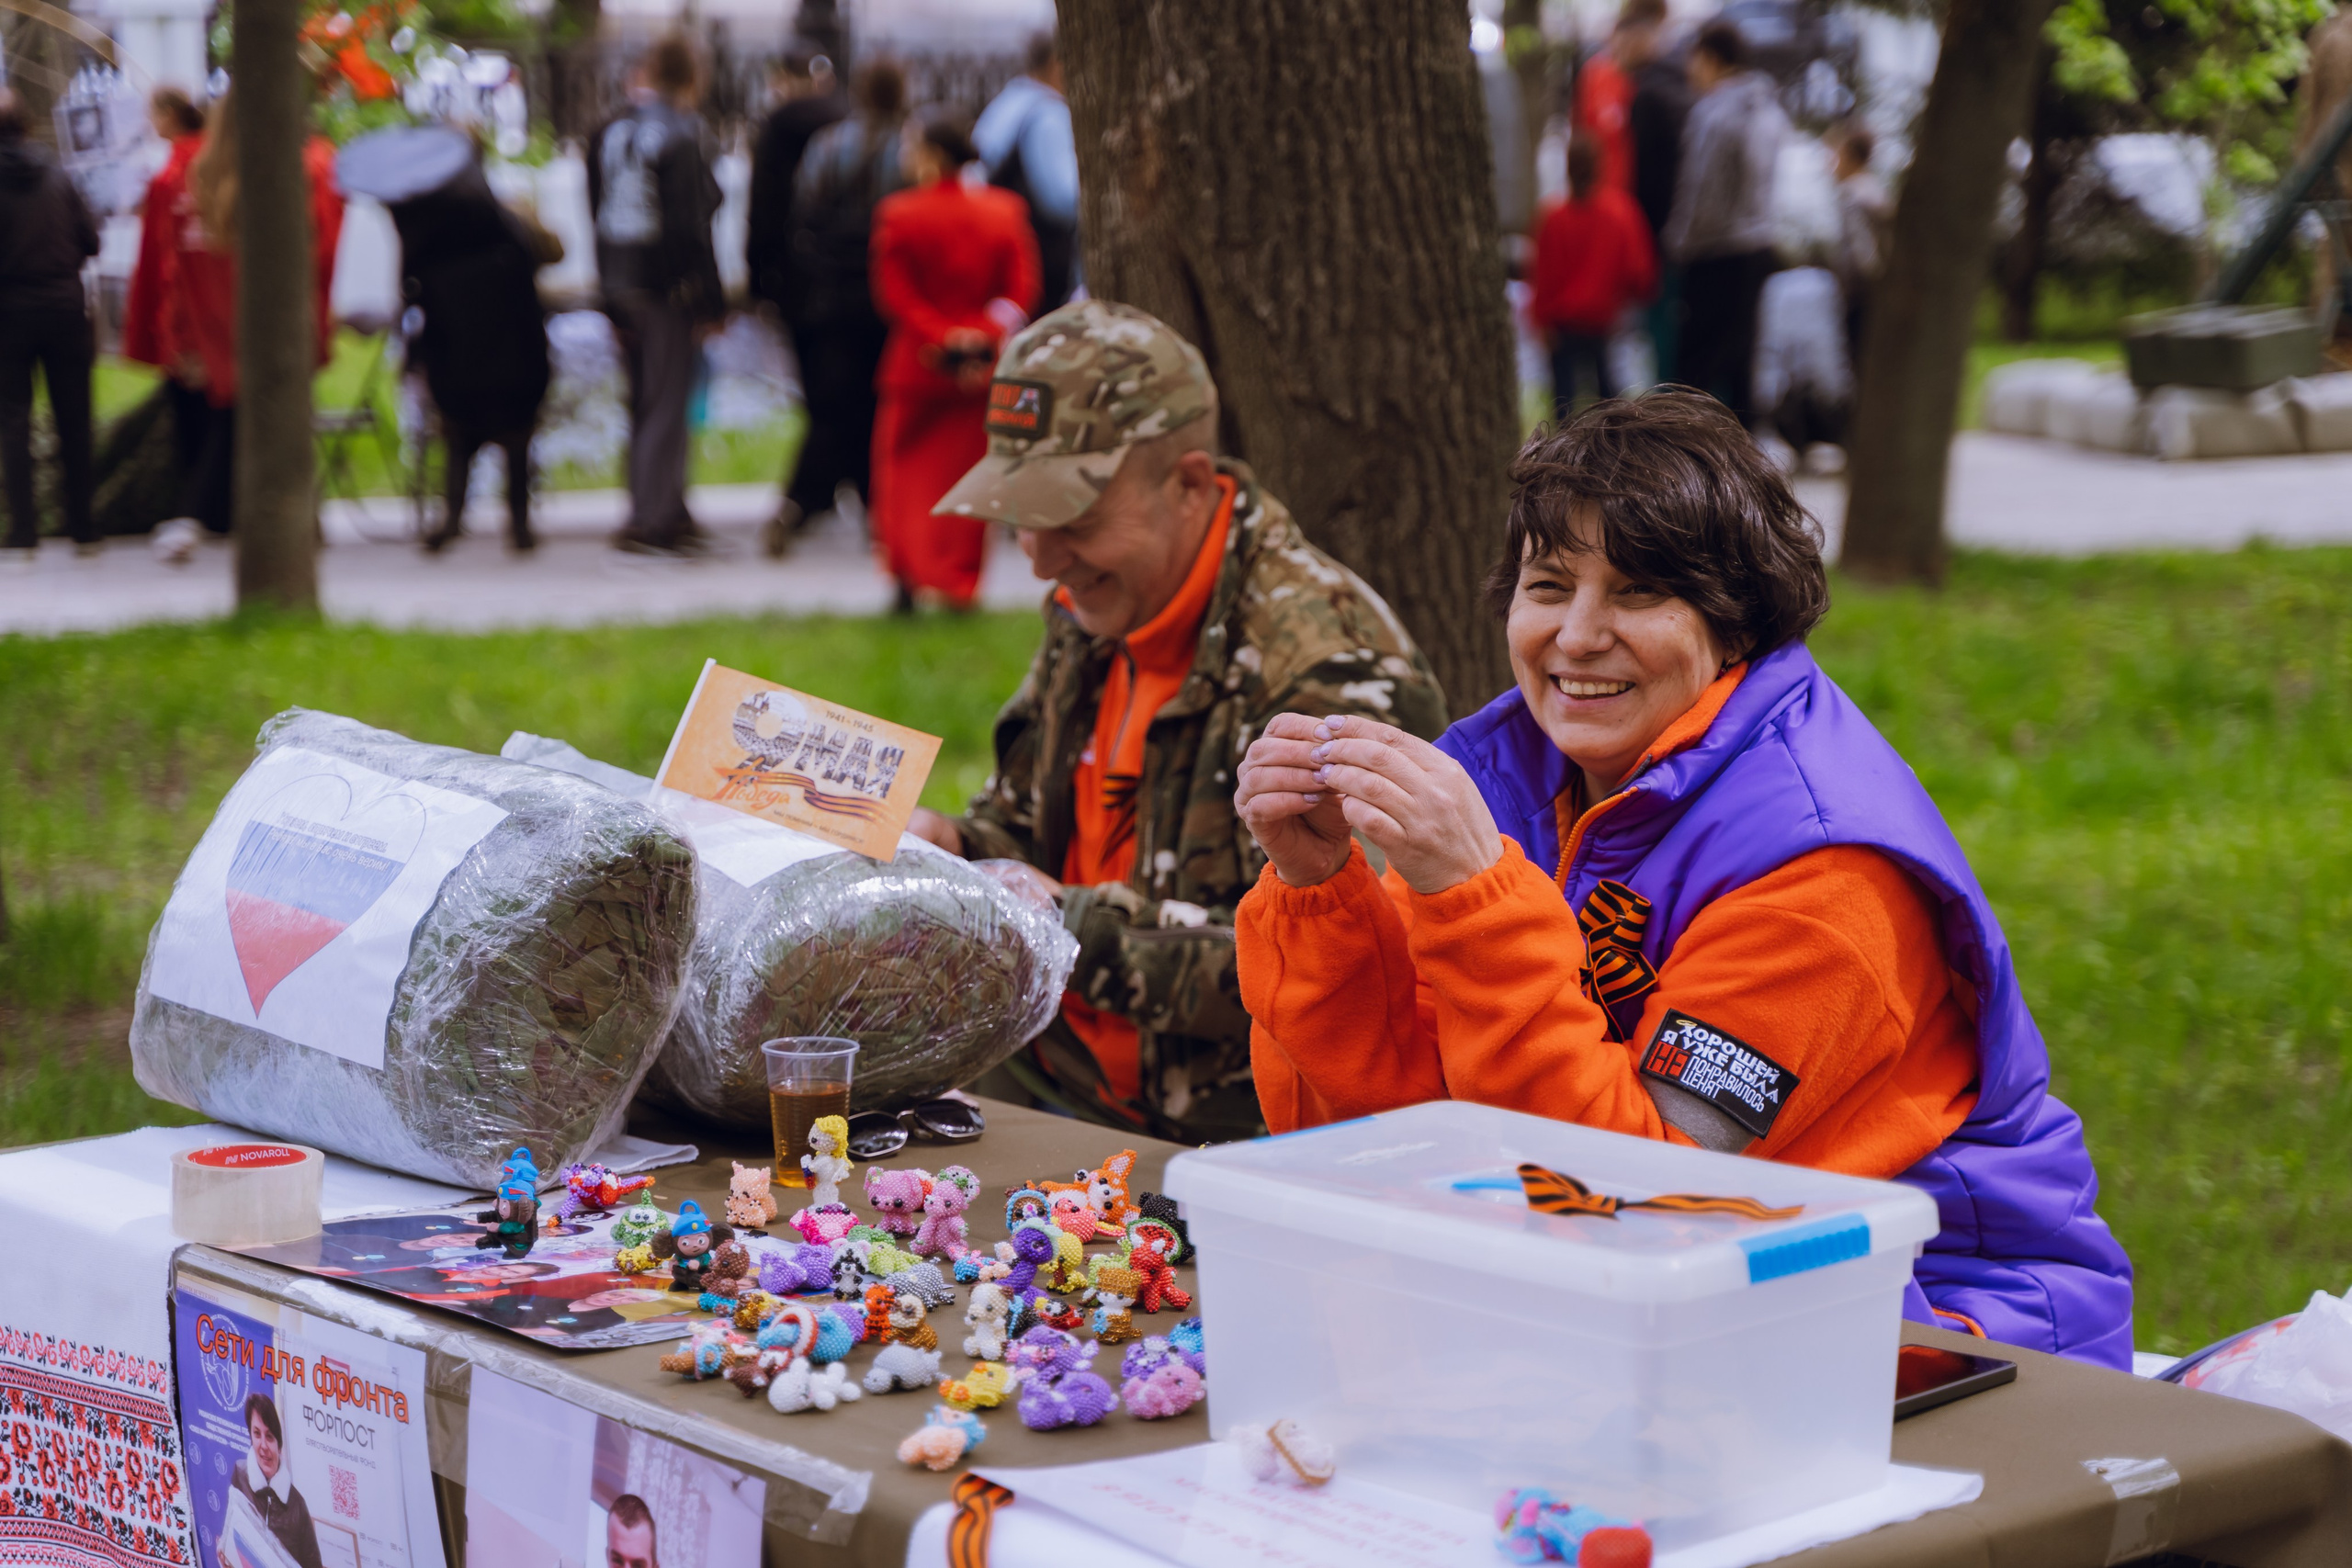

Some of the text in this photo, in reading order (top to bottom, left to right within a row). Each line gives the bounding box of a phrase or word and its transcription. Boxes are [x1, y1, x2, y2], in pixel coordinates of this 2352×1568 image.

[732, 691, 905, 798] 9 МАЯ
[826, 710, 845, 723] 1941
[854, 719, 874, 733] 1945
[712, 773, 789, 810] Победа
[332, 848, 357, 863] очень
[357, 856, 390, 872] верим!
[1646, 1042, 1765, 1112] НЕ ПОНРАВИЛОСЬ
[1660, 1030, 1779, 1104] Я УЖЕ БЫЛА
[1679, 1023, 1781, 1085] ХОРОШЕЙ
[1680, 1068, 1724, 1100] ЦЕНЯТ
[240, 1148, 290, 1161] NOVAROLL
[196, 1313, 255, 1370] Сети
[260, 1345, 306, 1388] для
[312, 1355, 410, 1424] фронта
[302, 1404, 376, 1450] ФОРПОСТ
